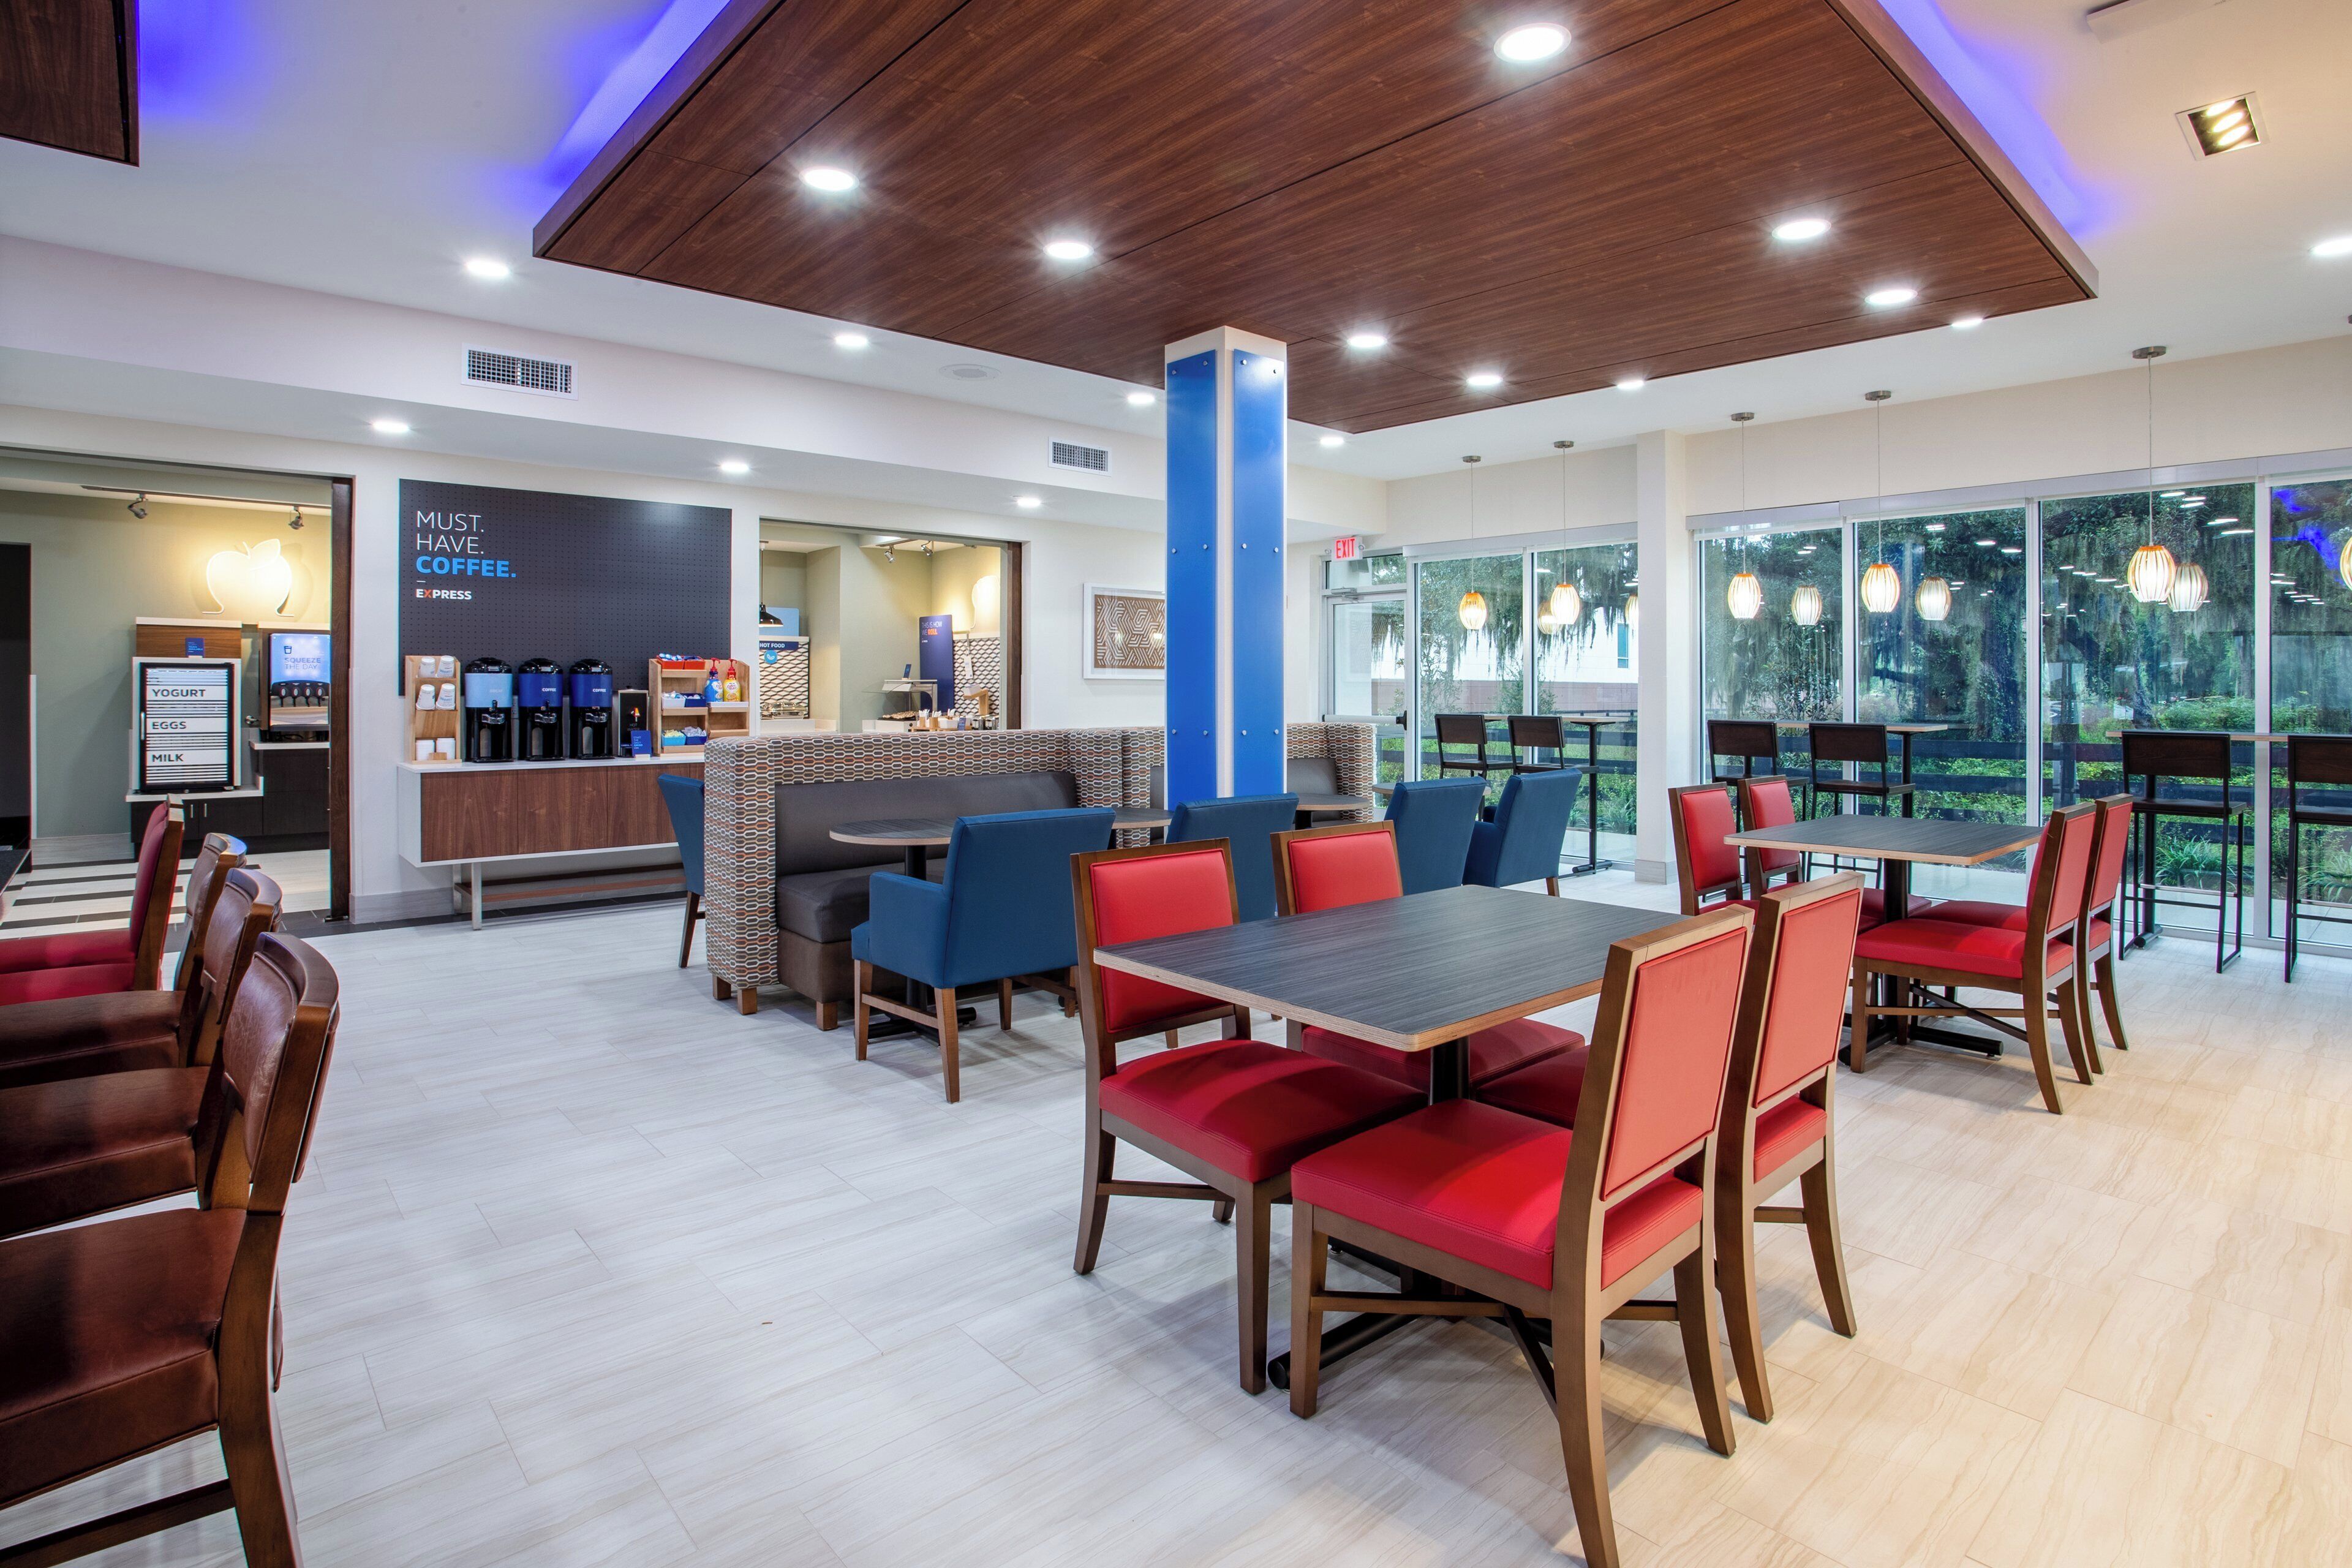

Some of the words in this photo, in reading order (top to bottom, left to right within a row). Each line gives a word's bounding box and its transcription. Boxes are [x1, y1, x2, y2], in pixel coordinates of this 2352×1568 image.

[417, 510, 484, 532] MUST.
[417, 533, 484, 554] HAVE.
[1336, 538, 1355, 559] EXIT
[416, 556, 517, 578] COFFEE.
[415, 589, 472, 600] EXPRESS
